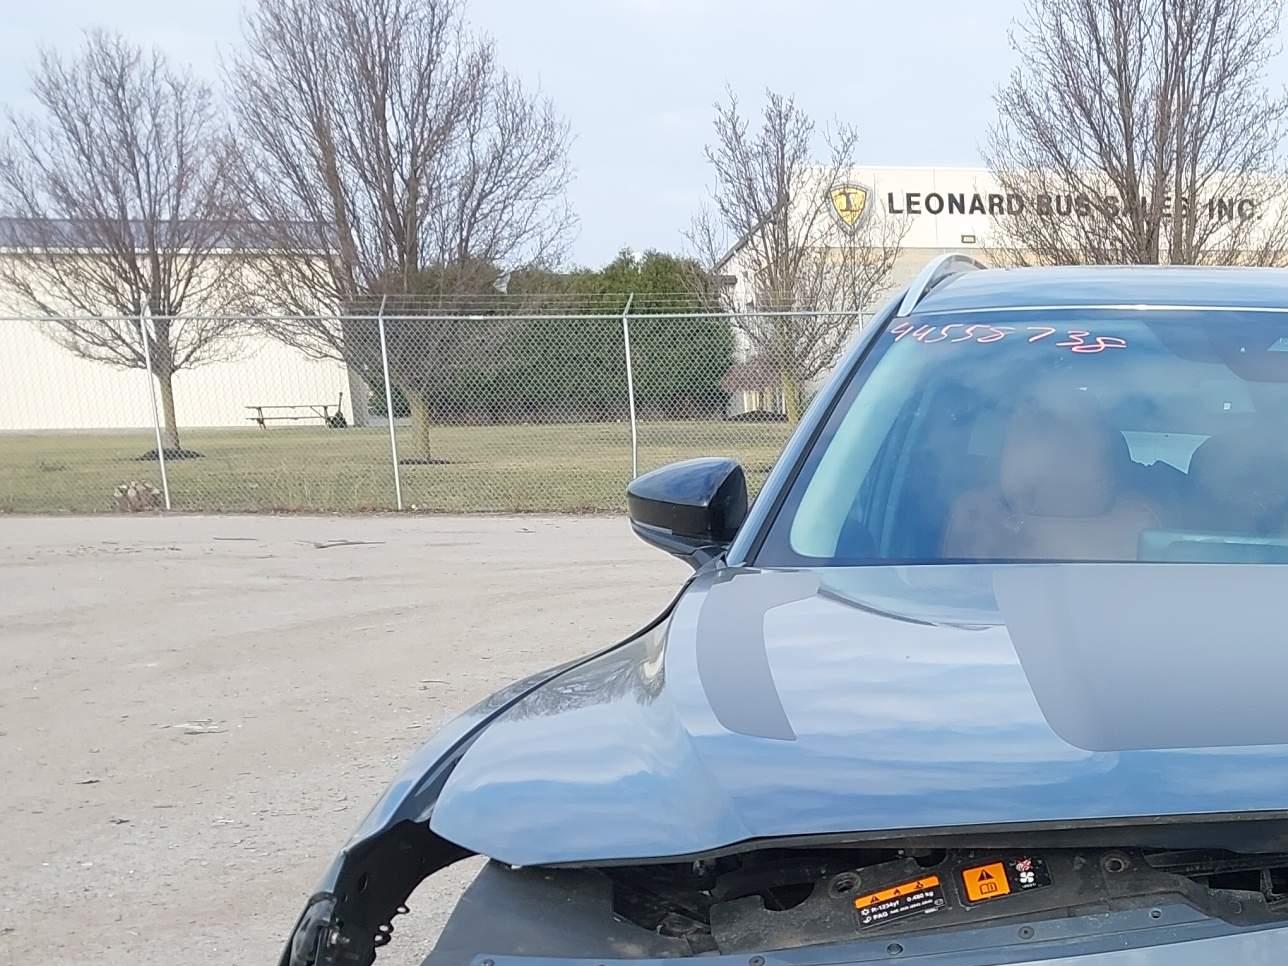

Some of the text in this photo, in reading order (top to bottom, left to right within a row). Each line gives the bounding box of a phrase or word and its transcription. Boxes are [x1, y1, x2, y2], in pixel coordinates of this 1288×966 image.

[888, 191, 1263, 221] LEONARD BUS SLES INC.
